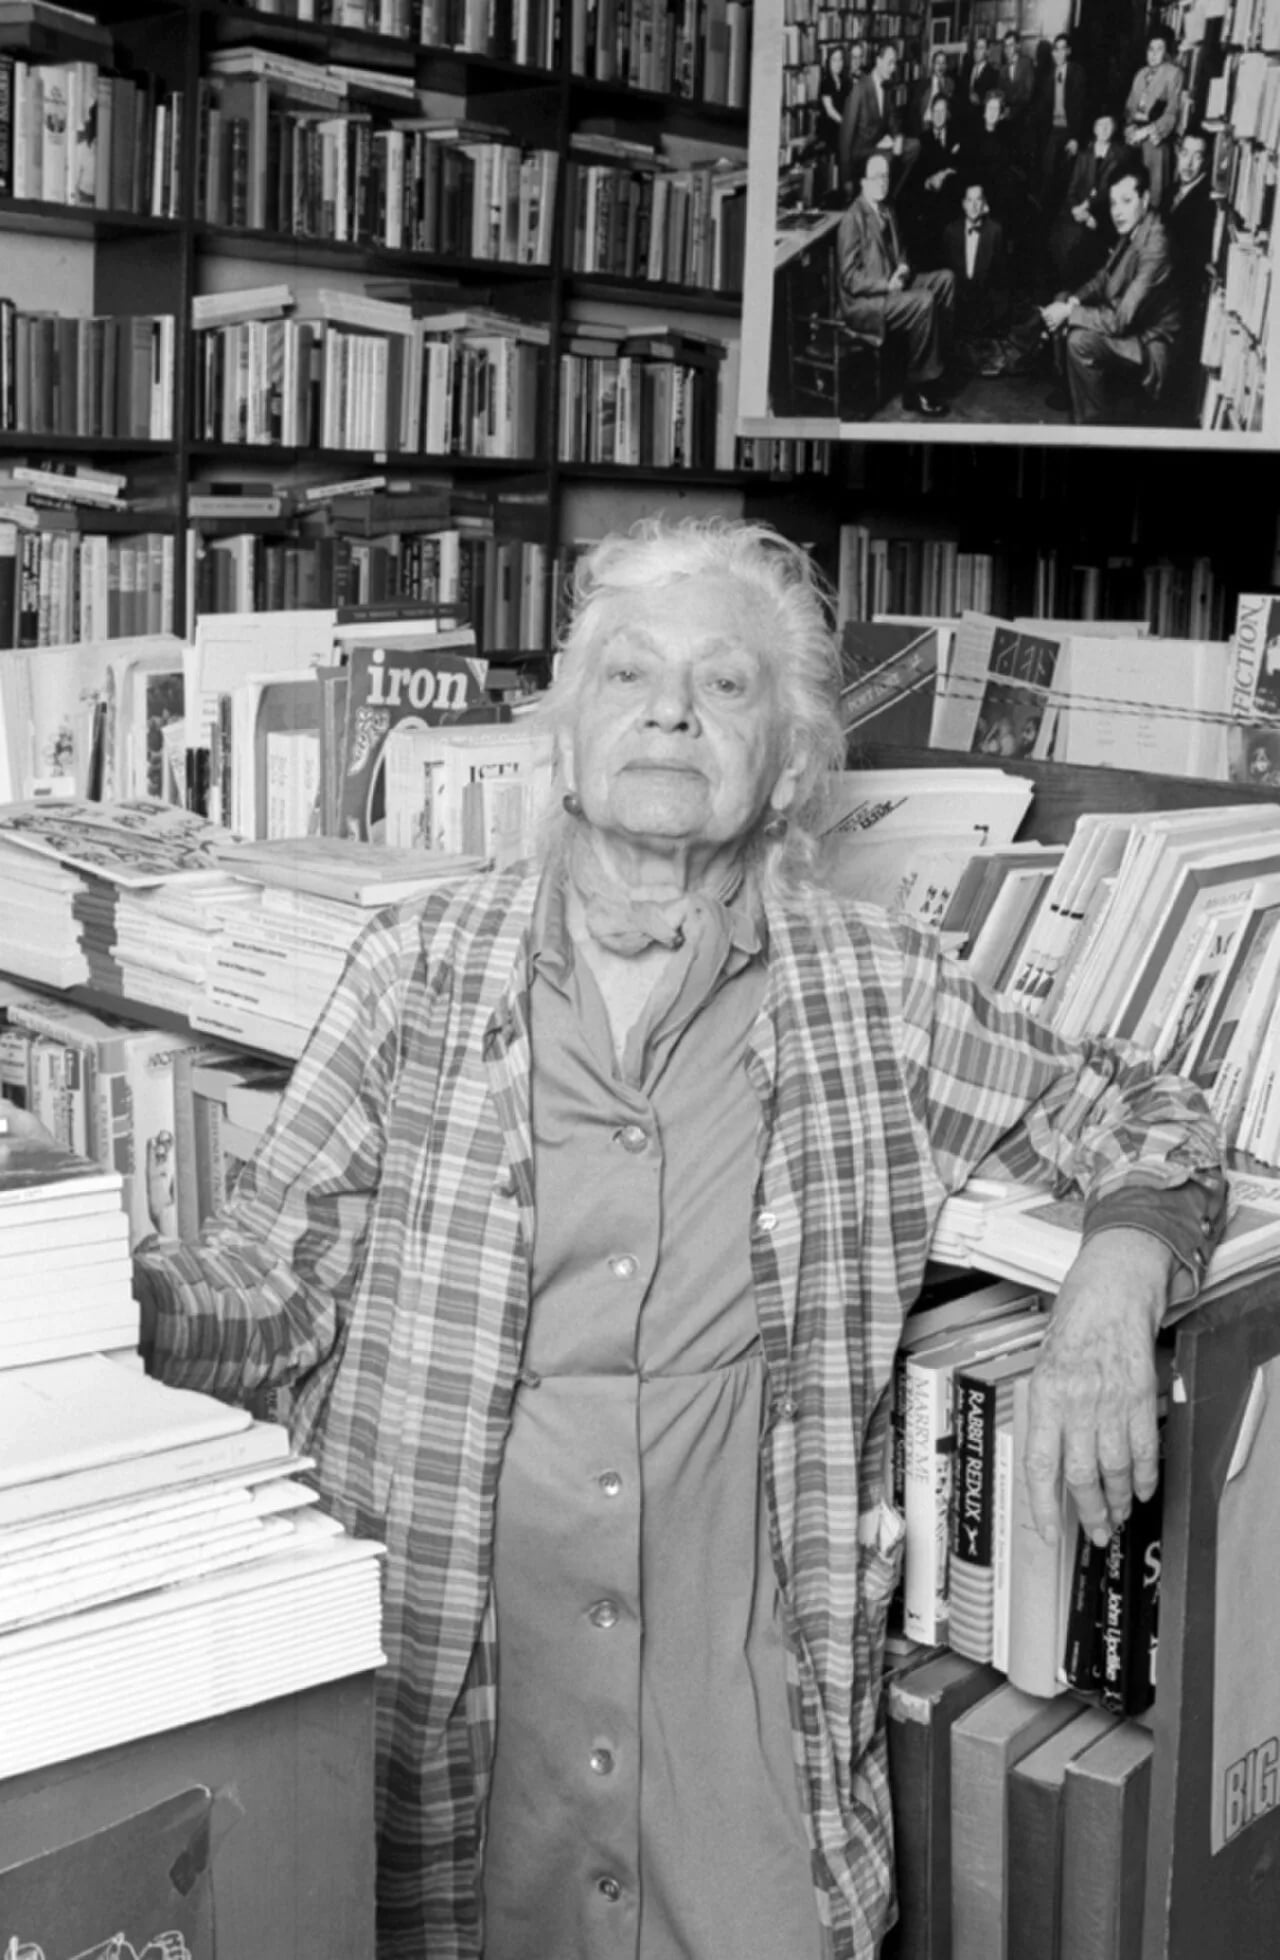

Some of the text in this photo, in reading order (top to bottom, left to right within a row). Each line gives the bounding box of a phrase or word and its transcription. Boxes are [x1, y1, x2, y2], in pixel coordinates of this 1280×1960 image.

[366, 648, 469, 710] iron
[1231, 598, 1267, 716] FICTION
[913, 1375, 930, 1487] MARRY ME
[964, 1388, 985, 1523] RABBIT REDUX
[1104, 1627, 1122, 1682] Updike
[1107, 1586, 1123, 1626] John
[1223, 1735, 1280, 1844] BIG
